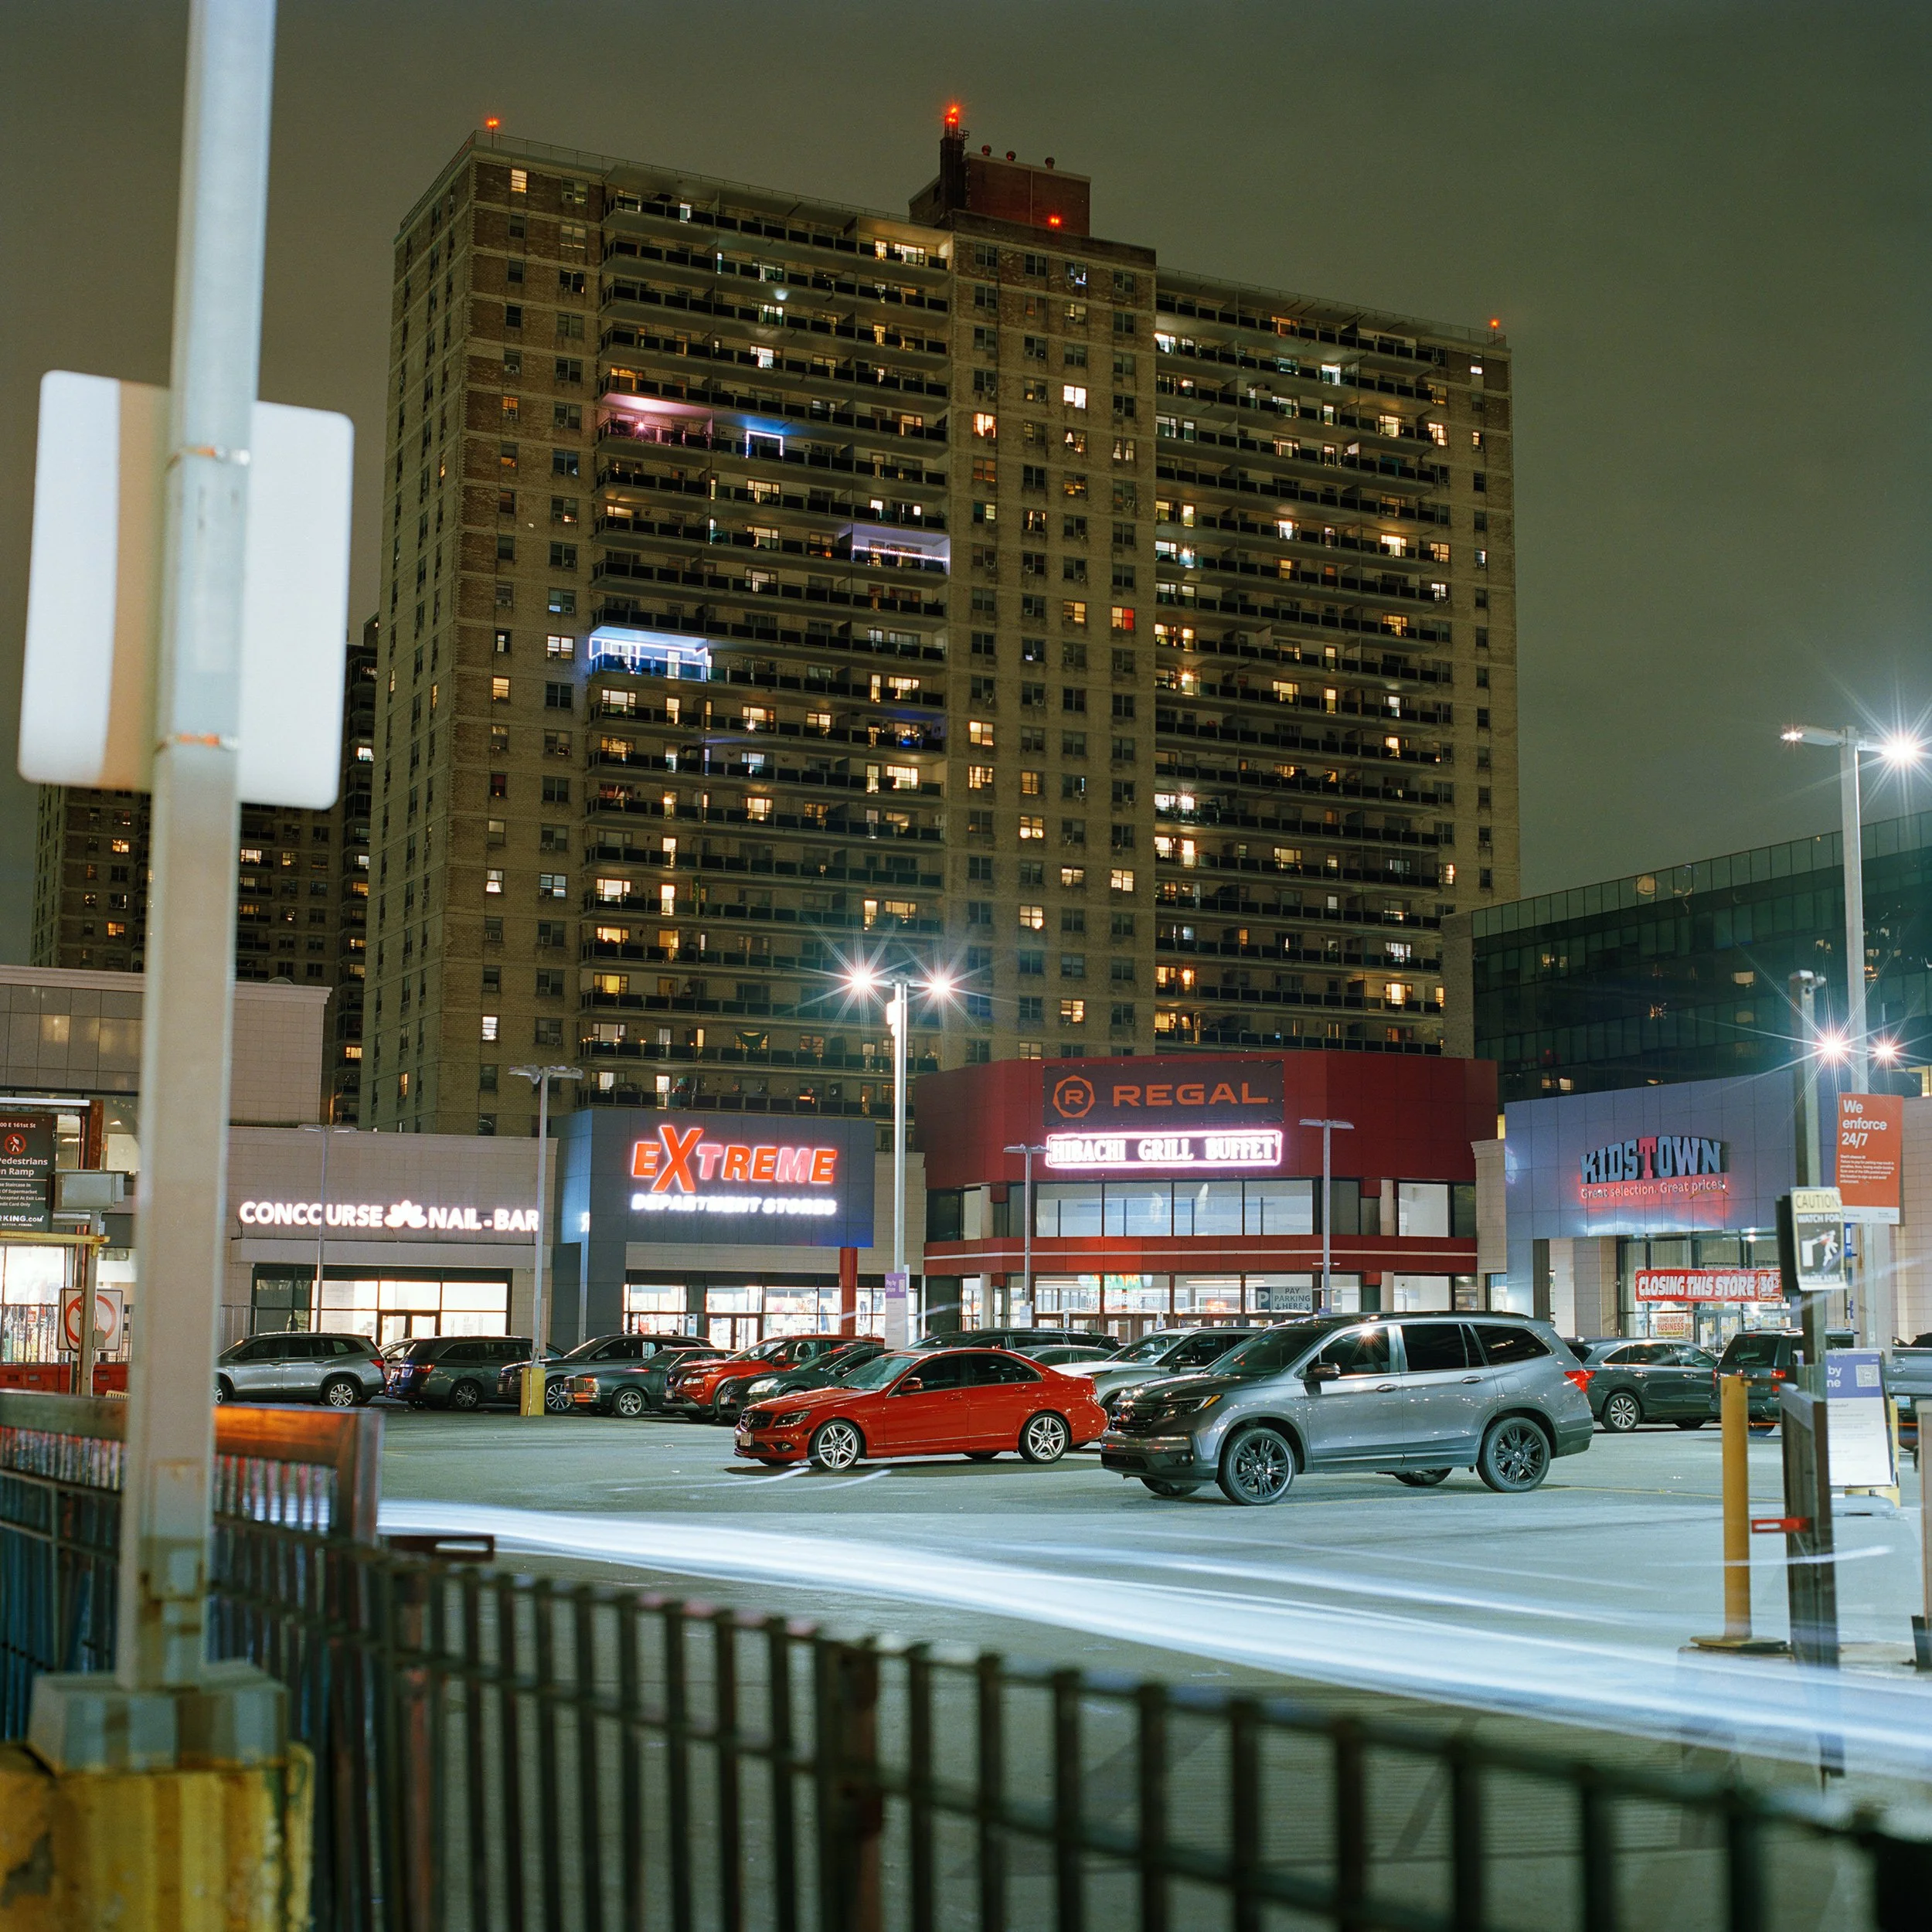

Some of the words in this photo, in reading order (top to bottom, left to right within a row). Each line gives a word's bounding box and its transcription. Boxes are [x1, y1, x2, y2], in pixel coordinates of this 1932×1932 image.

[1113, 1083, 1268, 1107] REGAL
[1843, 1100, 1863, 1114] We
[1842, 1117, 1887, 1131] enforce
[1842, 1132, 1868, 1149] 24/7
[1051, 1139, 1126, 1162] HIBACHI
[1138, 1138, 1194, 1162] GRILL
[1205, 1136, 1275, 1160] BUFFET
[1580, 1136, 1721, 1184] KIDSTOWN
[9, 1168, 34, 1178] Ramp
[1580, 1188, 1608, 1199] Great
[1610, 1183, 1658, 1197] selection.
[1660, 1182, 1689, 1193] Great
[1692, 1179, 1726, 1194] prices.
[1795, 1194, 1839, 1209] CAUTION
[1638, 1276, 1685, 1296] CLOSING
[1686, 1276, 1714, 1297] THIS
[1714, 1276, 1755, 1297] STORE
[1657, 1322, 1684, 1331] BUSINESS
[1828, 1366, 1842, 1377] by
